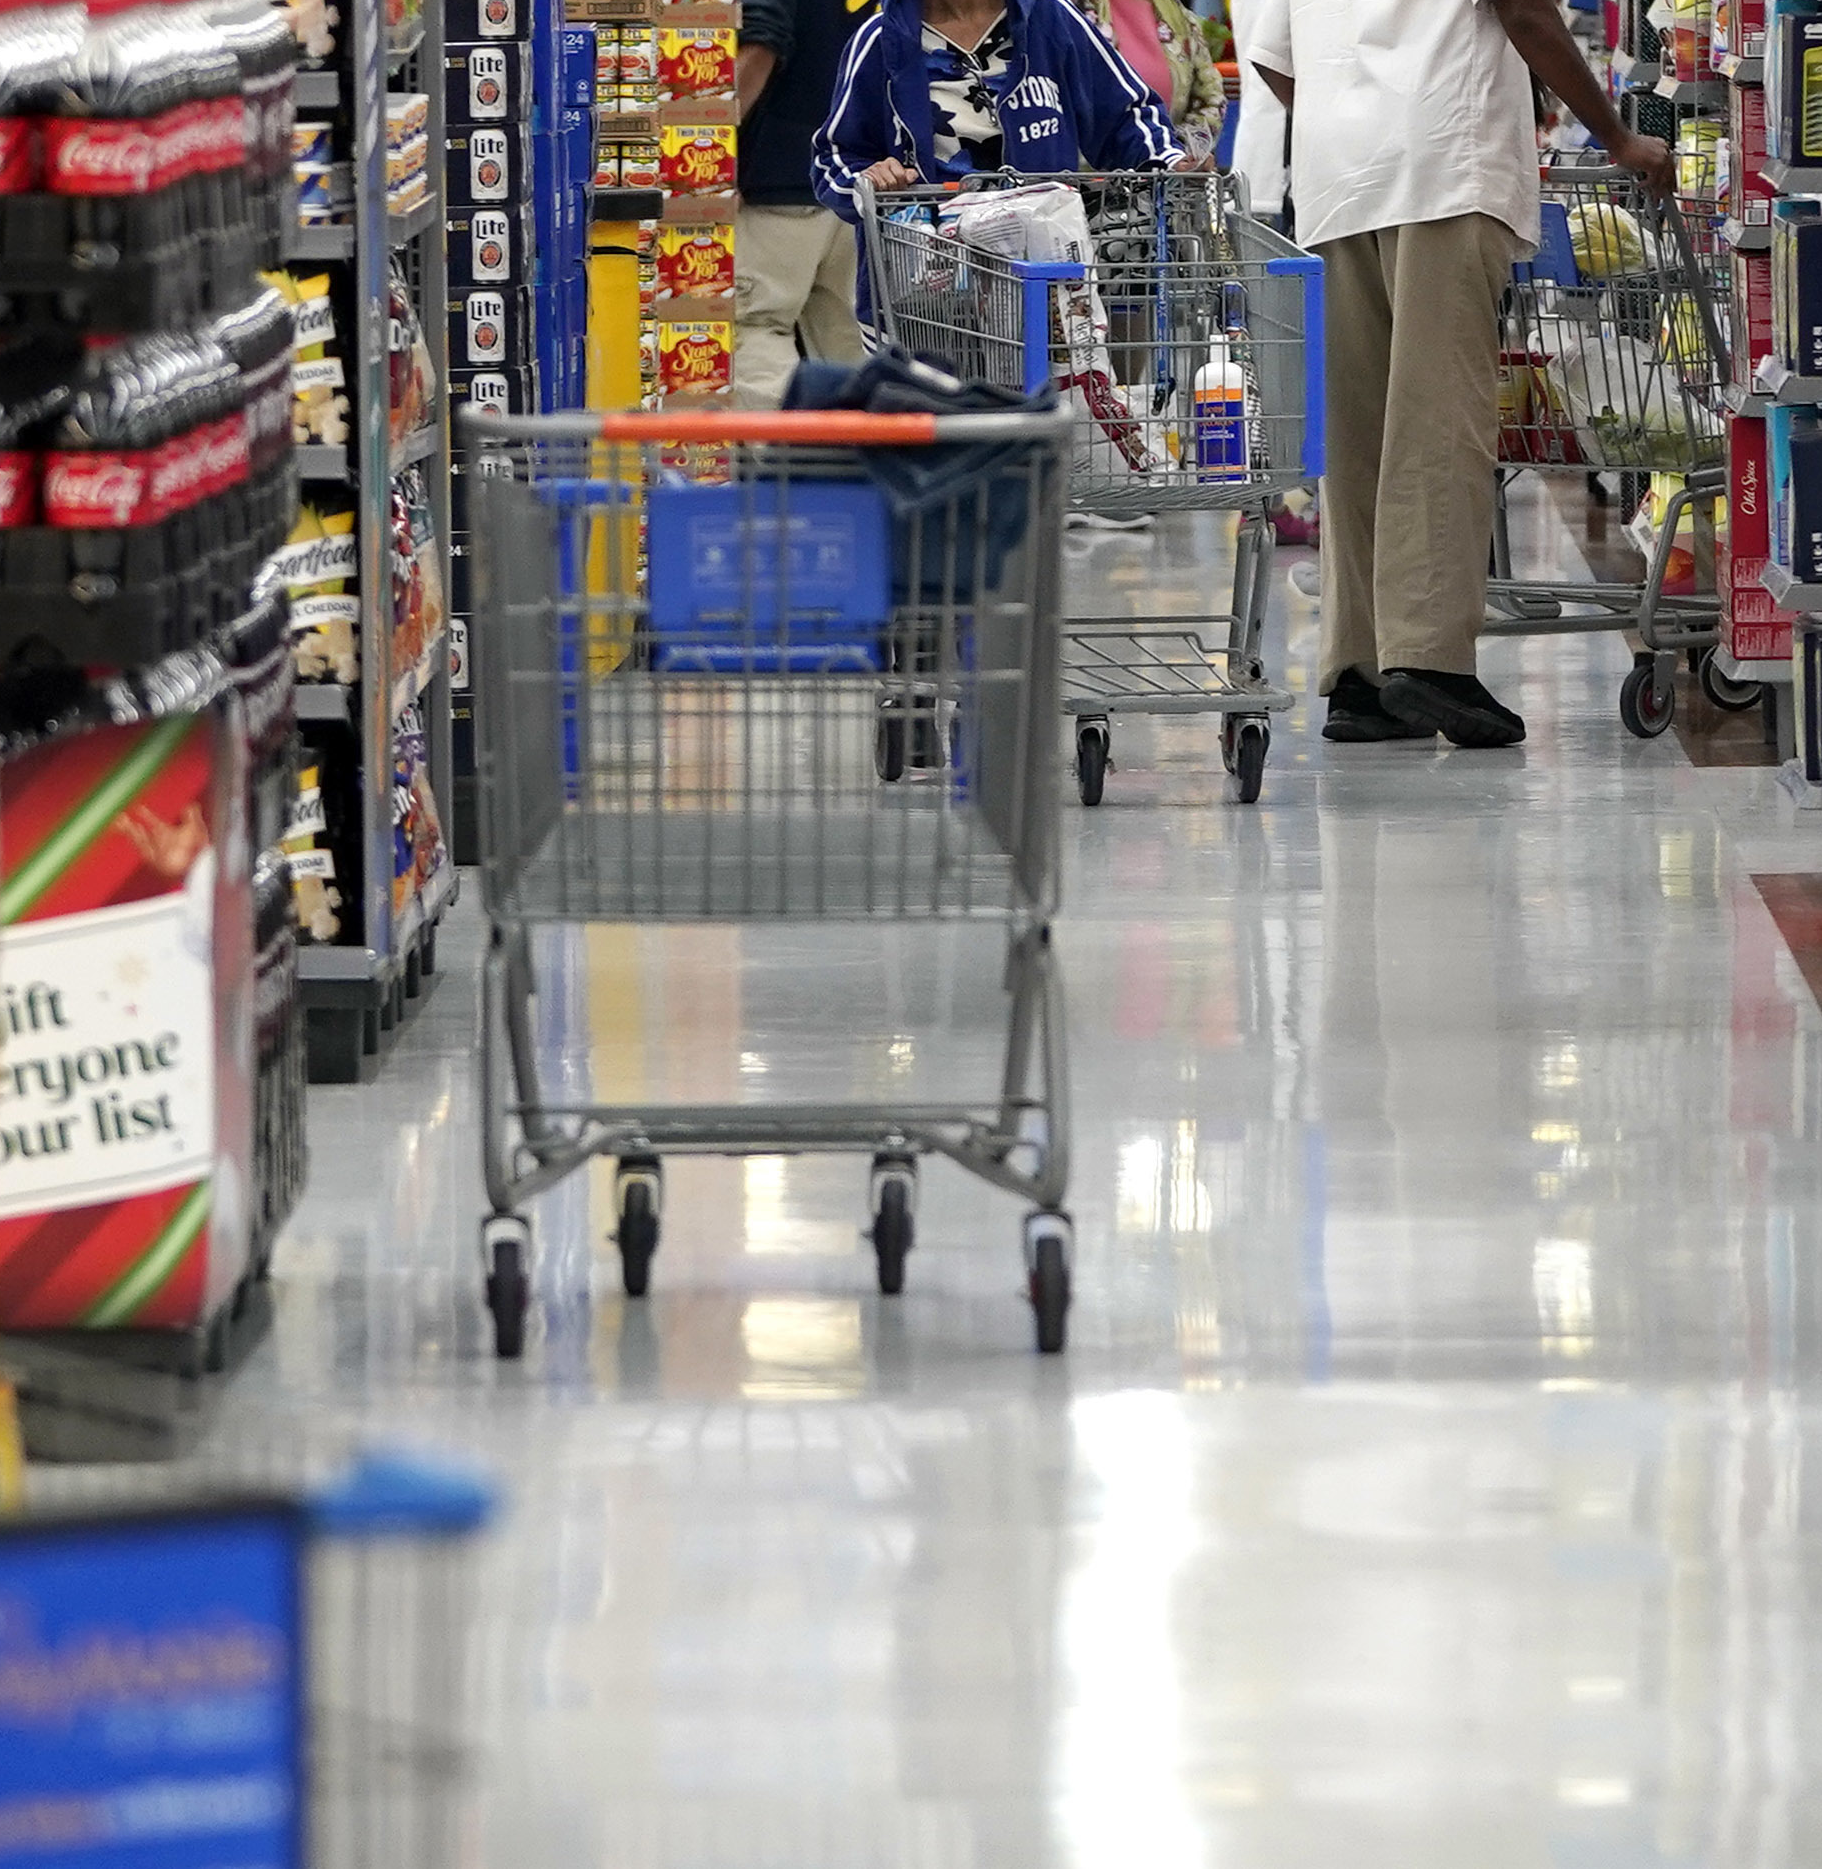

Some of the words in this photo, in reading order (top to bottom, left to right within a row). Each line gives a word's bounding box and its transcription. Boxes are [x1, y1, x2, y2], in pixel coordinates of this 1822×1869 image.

[566, 33, 585, 46] 24
[472, 56, 504, 78] Lite
[677, 47, 727, 80] Stove
[694, 64, 721, 84] Top
[1018, 116, 1060, 144] 1872
[474, 136, 505, 159] Lite
[677, 145, 727, 177] Stove
[695, 163, 720, 183] Top
[475, 218, 506, 240] Lite
[677, 244, 727, 277] Stove
[695, 261, 721, 281] Top
[470, 299, 502, 321] Lite
[672, 341, 723, 372] Stove
[690, 358, 716, 379] Top
[474, 381, 506, 402] Lite
[1740, 459, 1759, 491] Spice
[1740, 488, 1757, 515] Old
[91, 1091, 174, 1144] list
